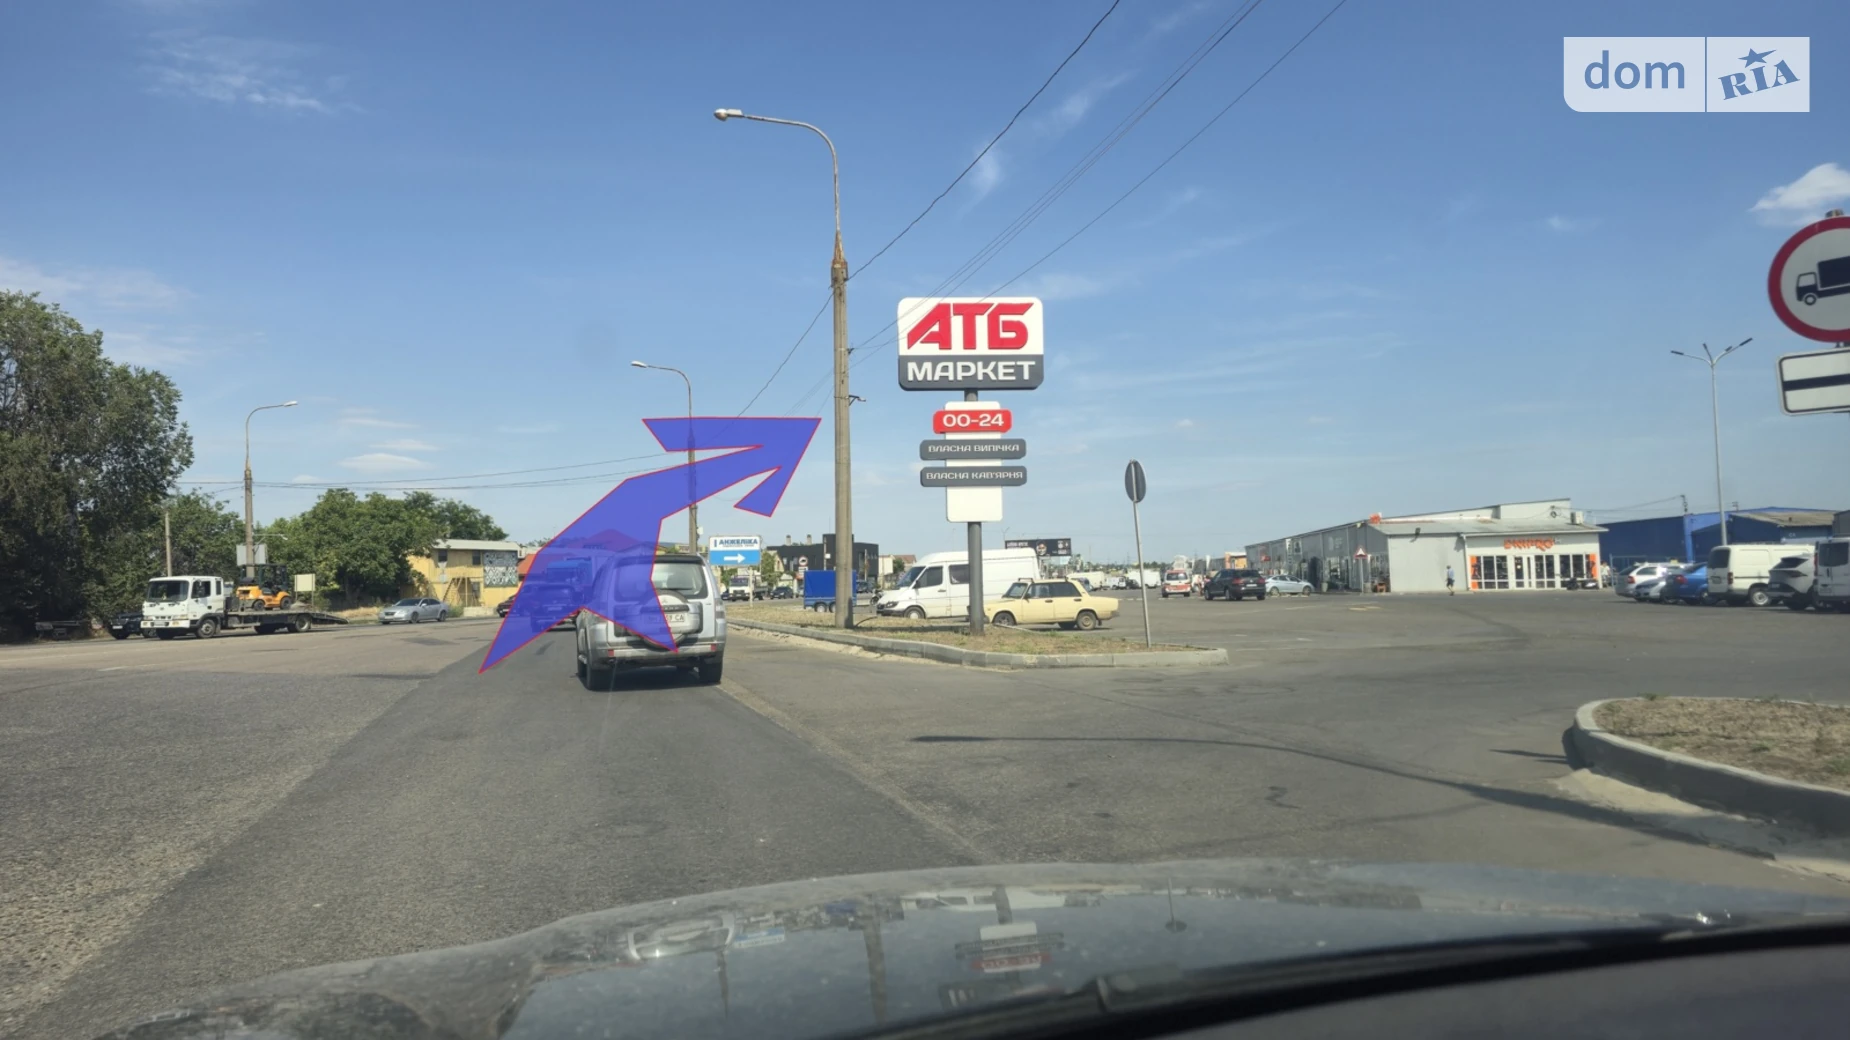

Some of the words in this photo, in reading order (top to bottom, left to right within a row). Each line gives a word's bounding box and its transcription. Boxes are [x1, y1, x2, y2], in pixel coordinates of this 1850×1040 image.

[907, 303, 1034, 350] АТБ
[907, 361, 1035, 381] МАРКЕТ
[943, 413, 1004, 427] 00-24
[928, 445, 971, 453] ВЛАСНА
[973, 444, 1019, 452] ВИПІЧКА
[926, 472, 969, 480] ВЛАСНА
